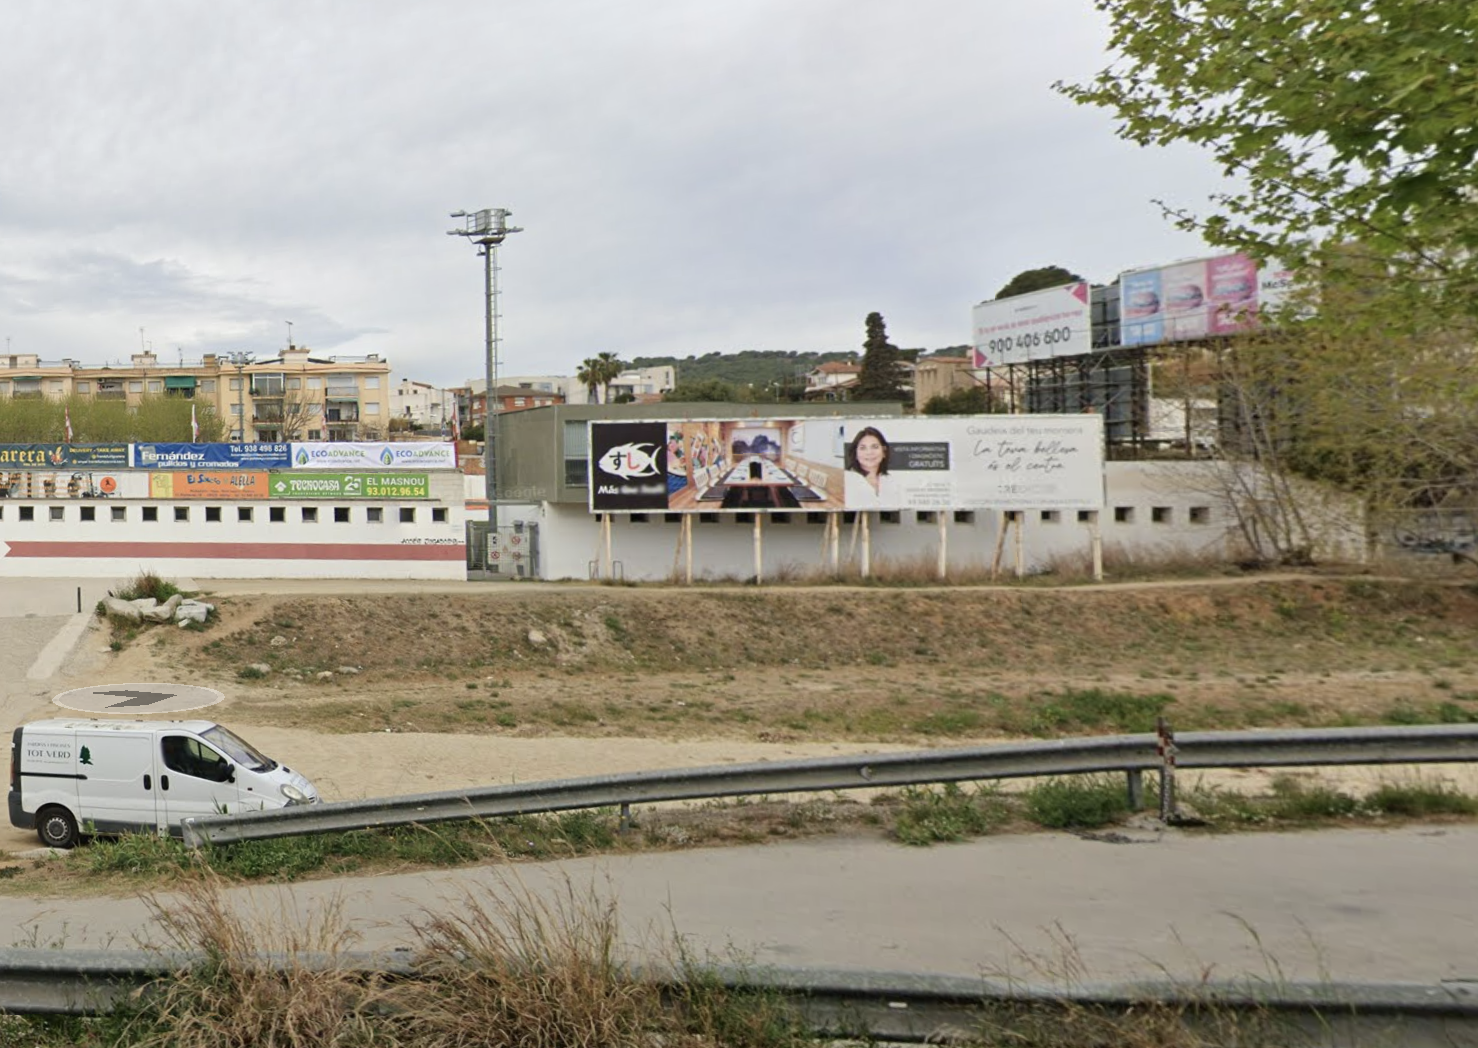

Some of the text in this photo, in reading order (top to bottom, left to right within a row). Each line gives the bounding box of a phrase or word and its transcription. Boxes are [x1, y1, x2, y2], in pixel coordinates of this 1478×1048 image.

[989, 326, 1071, 354] 900 406 600
[142, 451, 205, 461] Fernández
[311, 450, 365, 458] ECOADVANCE
[395, 450, 450, 458] ECOADVANCE
[158, 460, 188, 468] pulidos
[197, 460, 239, 468] cromados
[609, 452, 640, 470] すし
[289, 479, 340, 491] TECNOCASA
[366, 477, 425, 486] EL MASNOU
[366, 487, 425, 496] 93.012.96.54
[46, 750, 71, 759] VERD
